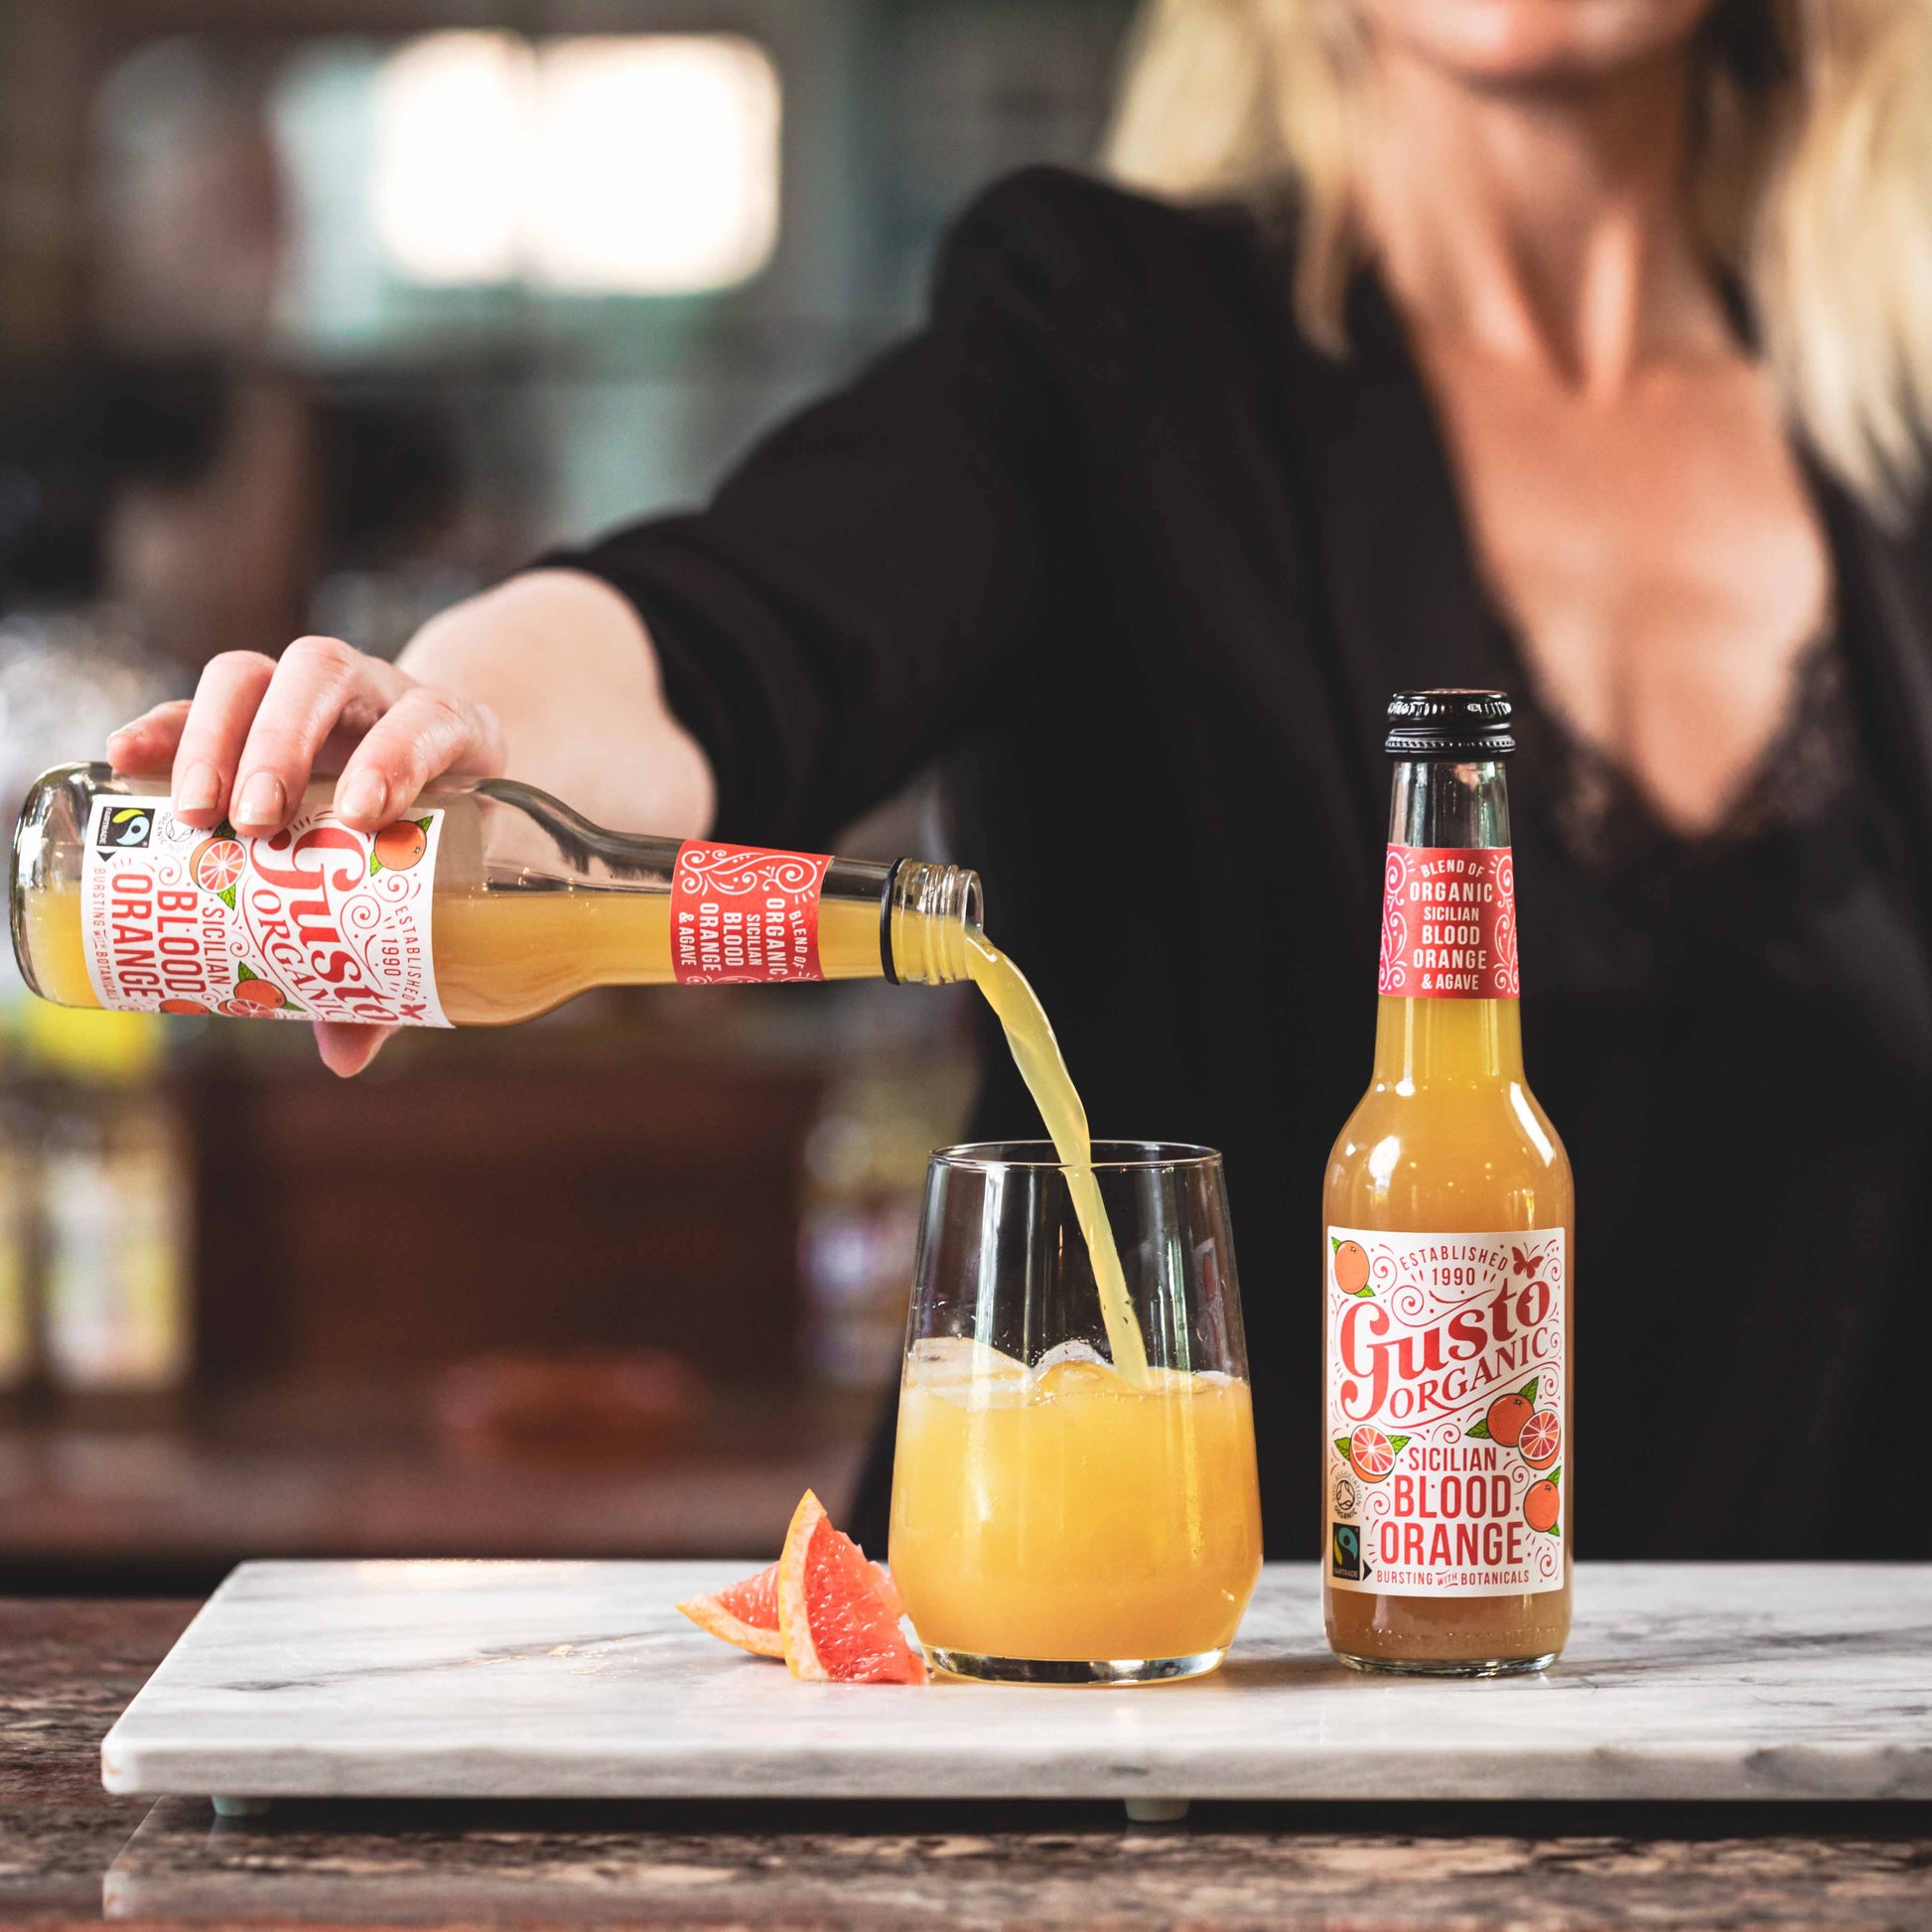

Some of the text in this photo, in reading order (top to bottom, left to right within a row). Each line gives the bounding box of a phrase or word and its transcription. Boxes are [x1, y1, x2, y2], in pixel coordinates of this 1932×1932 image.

[98, 807, 112, 845] FAIRTRADE
[1410, 882, 1493, 902] ORGANIC
[1420, 860, 1485, 878] BLEND OF
[93, 868, 112, 925] BURSTING
[1424, 907, 1479, 921] SICILIAN
[112, 874, 165, 998] ORANGE
[157, 891, 206, 993] BLOOD
[203, 907, 232, 985] SICILIAN
[250, 827, 398, 1022] Gusto
[679, 911, 697, 965] & AGAVE
[699, 902, 722, 971] ORANGE
[723, 912, 744, 966] BLOOD
[747, 913, 762, 965] SICILIAN
[765, 898, 787, 975] ORGANIC
[788, 910, 807, 970] BLEND OF
[1422, 925, 1480, 944] BLOOD
[251, 890, 351, 1020] ORGANIC
[381, 938, 401, 977] 1990
[395, 906, 422, 1001] ESTABLISHED
[1414, 949, 1487, 969] ORANGE
[1422, 974, 1478, 990] & AGAVE
[1399, 1246, 1508, 1272] ESTABLISHED
[1432, 1267, 1476, 1286] 1990
[1340, 1278, 1551, 1422] Gusto
[1390, 1326, 1549, 1419] ORGANIC
[1409, 1447, 1497, 1471] SICILIAN
[1394, 1474, 1511, 1519] BLOOD
[1380, 1521, 1524, 1567] ORANGE
[1377, 1570, 1433, 1586] BURSTING
[1460, 1570, 1529, 1586] BOTANICALS
